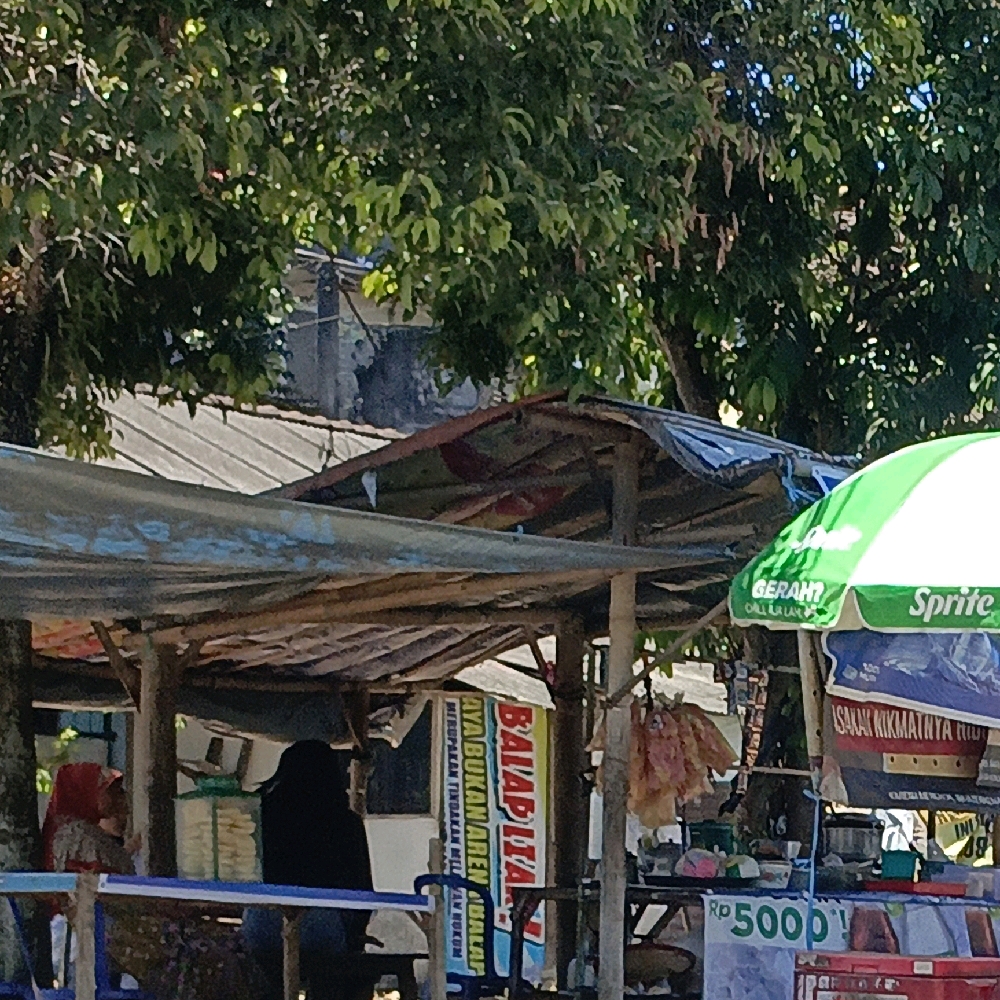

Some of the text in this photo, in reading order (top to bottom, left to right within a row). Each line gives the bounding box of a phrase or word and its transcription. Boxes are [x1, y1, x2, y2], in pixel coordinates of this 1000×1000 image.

[751, 578, 824, 602] GERAH?
[909, 587, 994, 622] Sprite
[873, 709, 954, 741] NIKMATNYA
[498, 702, 536, 821] BALAP
[464, 740, 489, 823] BUKAN
[708, 900, 731, 921] Rp
